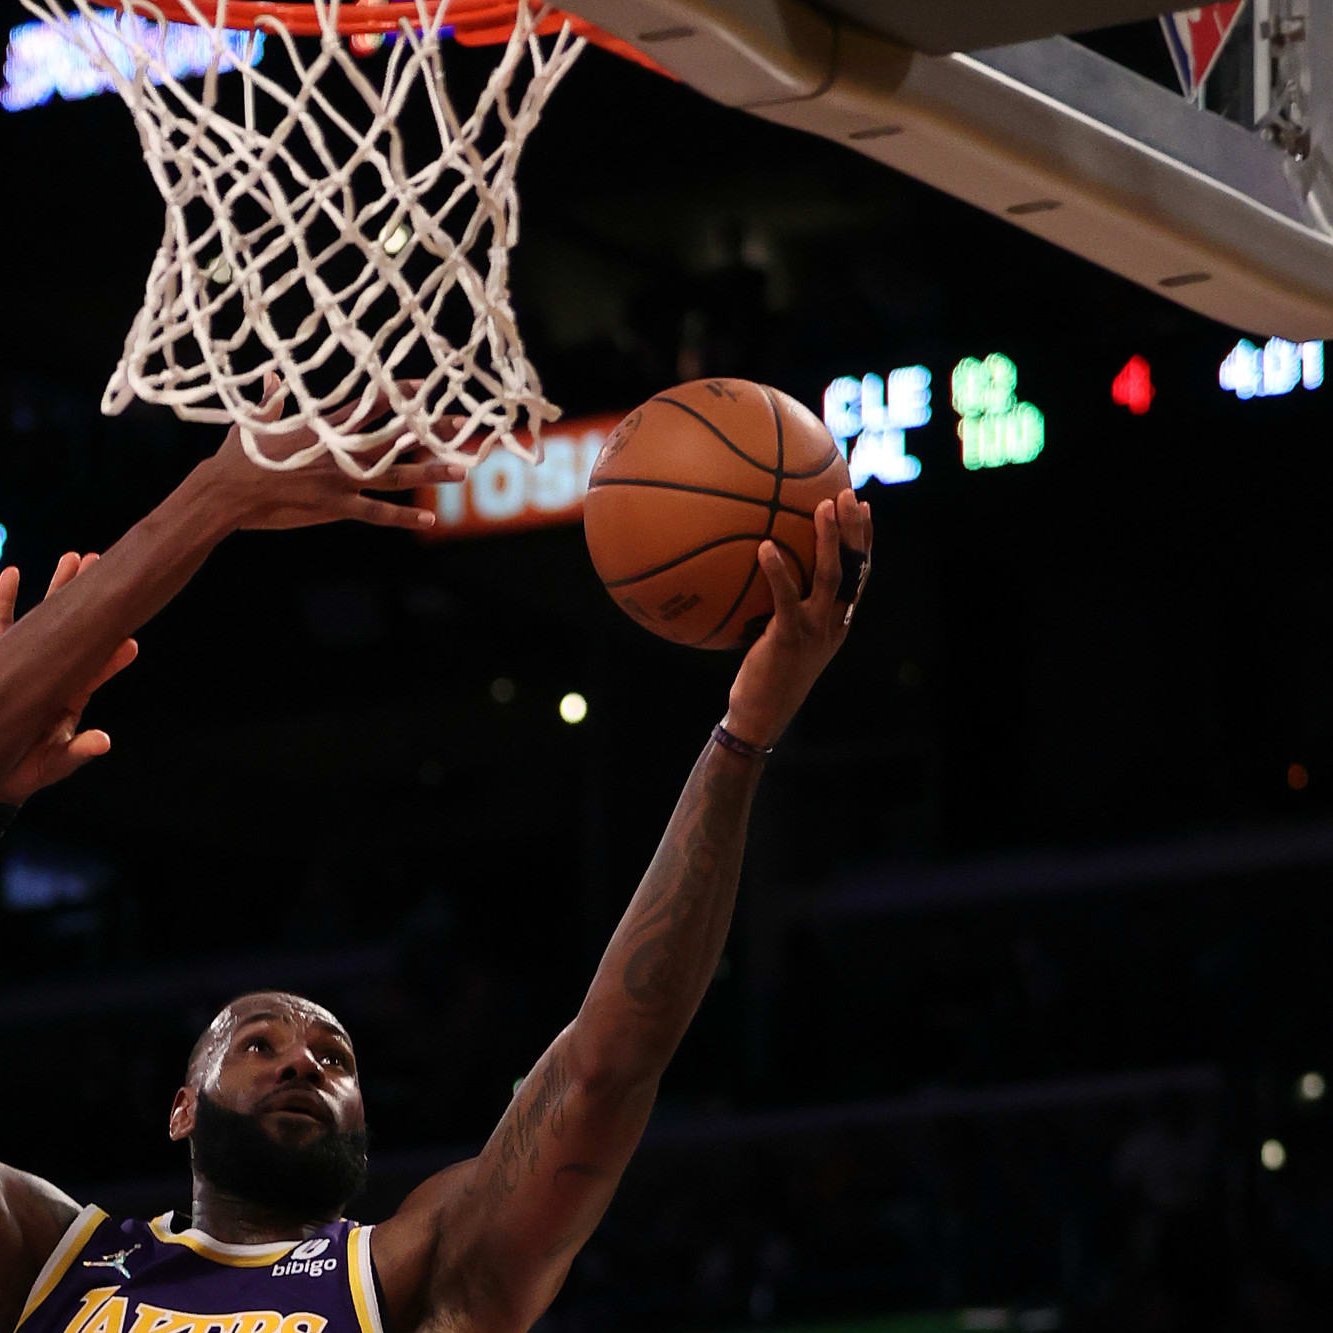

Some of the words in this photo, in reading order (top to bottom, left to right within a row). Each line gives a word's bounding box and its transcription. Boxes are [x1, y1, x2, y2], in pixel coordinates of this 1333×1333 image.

[825, 366, 931, 437] CLE
[835, 428, 921, 489] AL
[271, 1258, 337, 1277] bibigo
